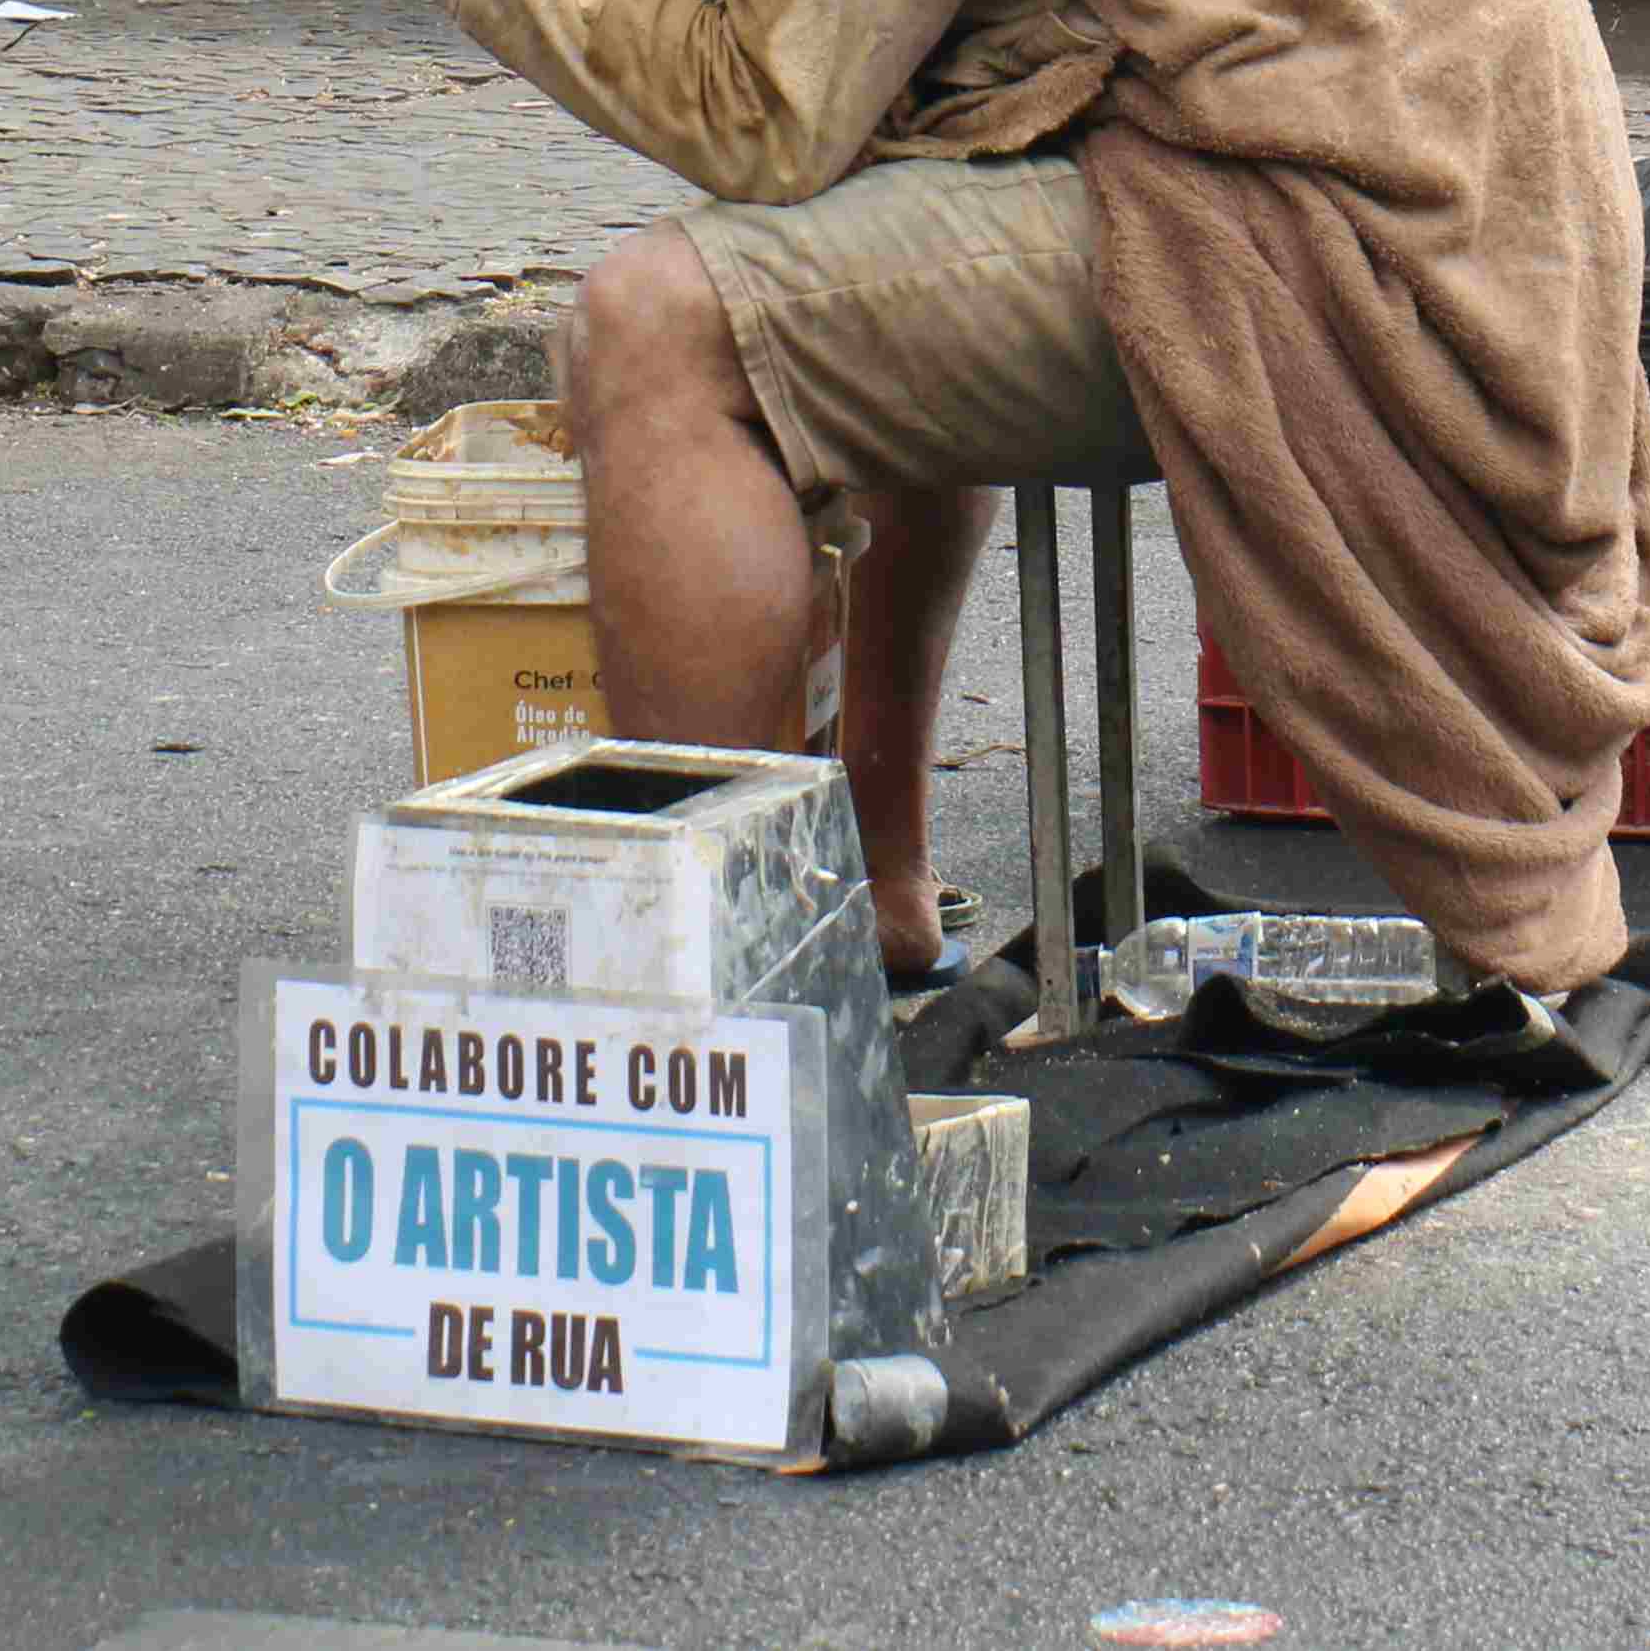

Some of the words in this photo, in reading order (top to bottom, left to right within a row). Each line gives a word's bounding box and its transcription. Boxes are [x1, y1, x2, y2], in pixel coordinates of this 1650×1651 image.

[514, 669, 574, 690] Chef
[515, 698, 558, 724] Óleo
[563, 702, 588, 724] de
[307, 1018, 598, 1106] COLABORE
[626, 1043, 748, 1119] COM
[321, 1135, 375, 1264] O
[393, 1143, 740, 1295] ARTISTA
[426, 1301, 496, 1382] DE
[509, 1308, 625, 1395] RUA
